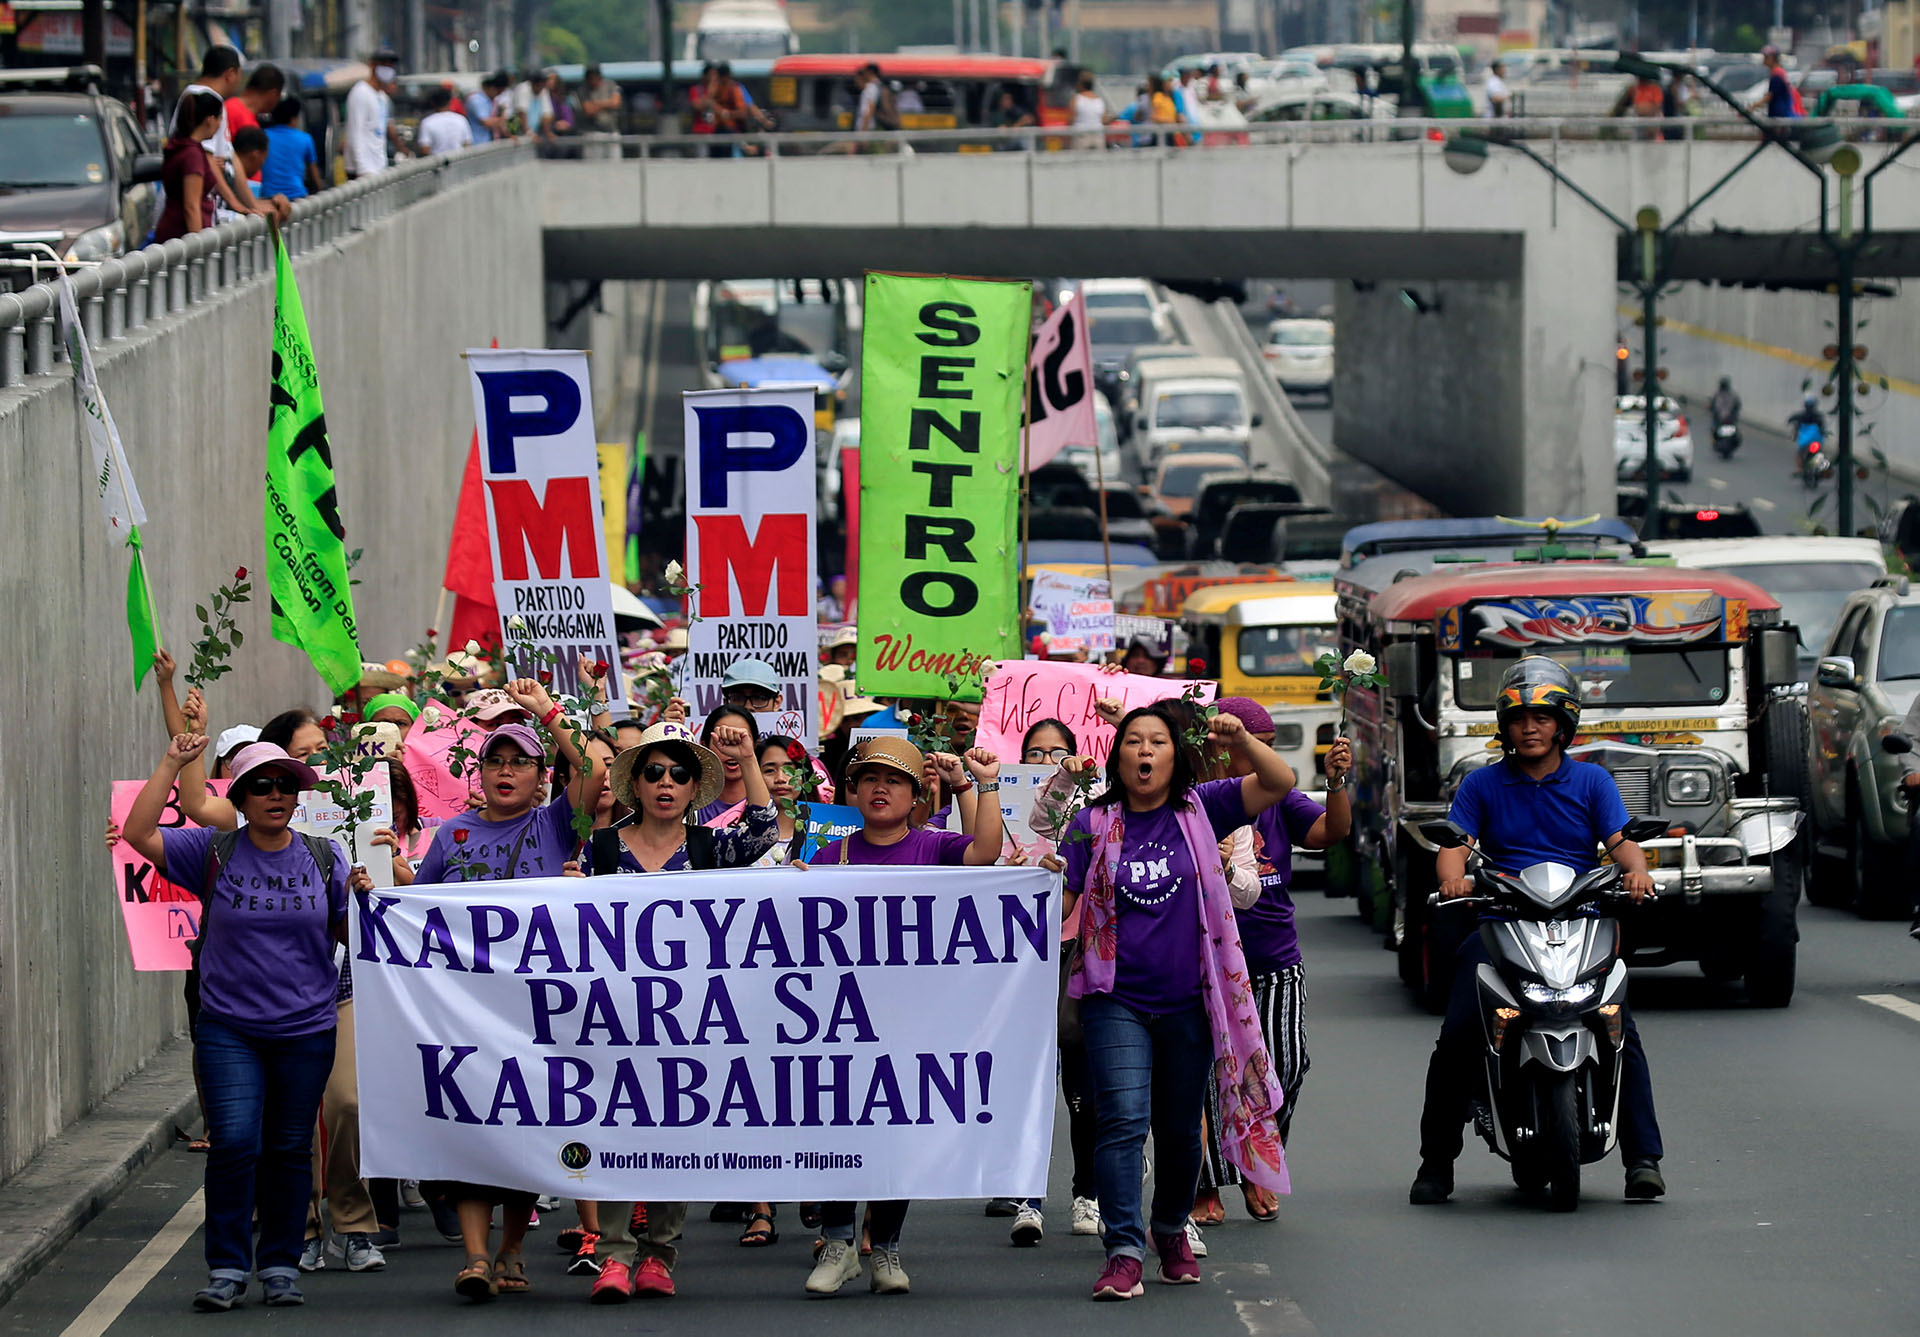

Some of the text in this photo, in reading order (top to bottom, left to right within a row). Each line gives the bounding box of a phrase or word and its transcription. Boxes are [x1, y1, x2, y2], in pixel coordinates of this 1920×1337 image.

[899, 300, 981, 618] SENTRO
[273, 532, 322, 614] Coalition
[303, 550, 337, 599] from
[334, 599, 361, 650] Deb
[514, 585, 585, 612] PARTIDO
[718, 623, 788, 649] PARTIDO
[315, 812, 331, 821] BE
[228, 872, 311, 891] WOMEN
[1129, 857, 1171, 883] PM
[231, 893, 317, 911] RESIST
[355, 891, 1051, 974] KAPANGYARIHAN
[525, 972, 880, 1046] PARA SA
[416, 1043, 994, 1128] KABABAIHAN!
[600, 1152, 648, 1169] World
[652, 1152, 701, 1170] March
[704, 1152, 720, 1169] of
[722, 1152, 783, 1170] Women
[794, 1152, 863, 1171] Pilipinas
